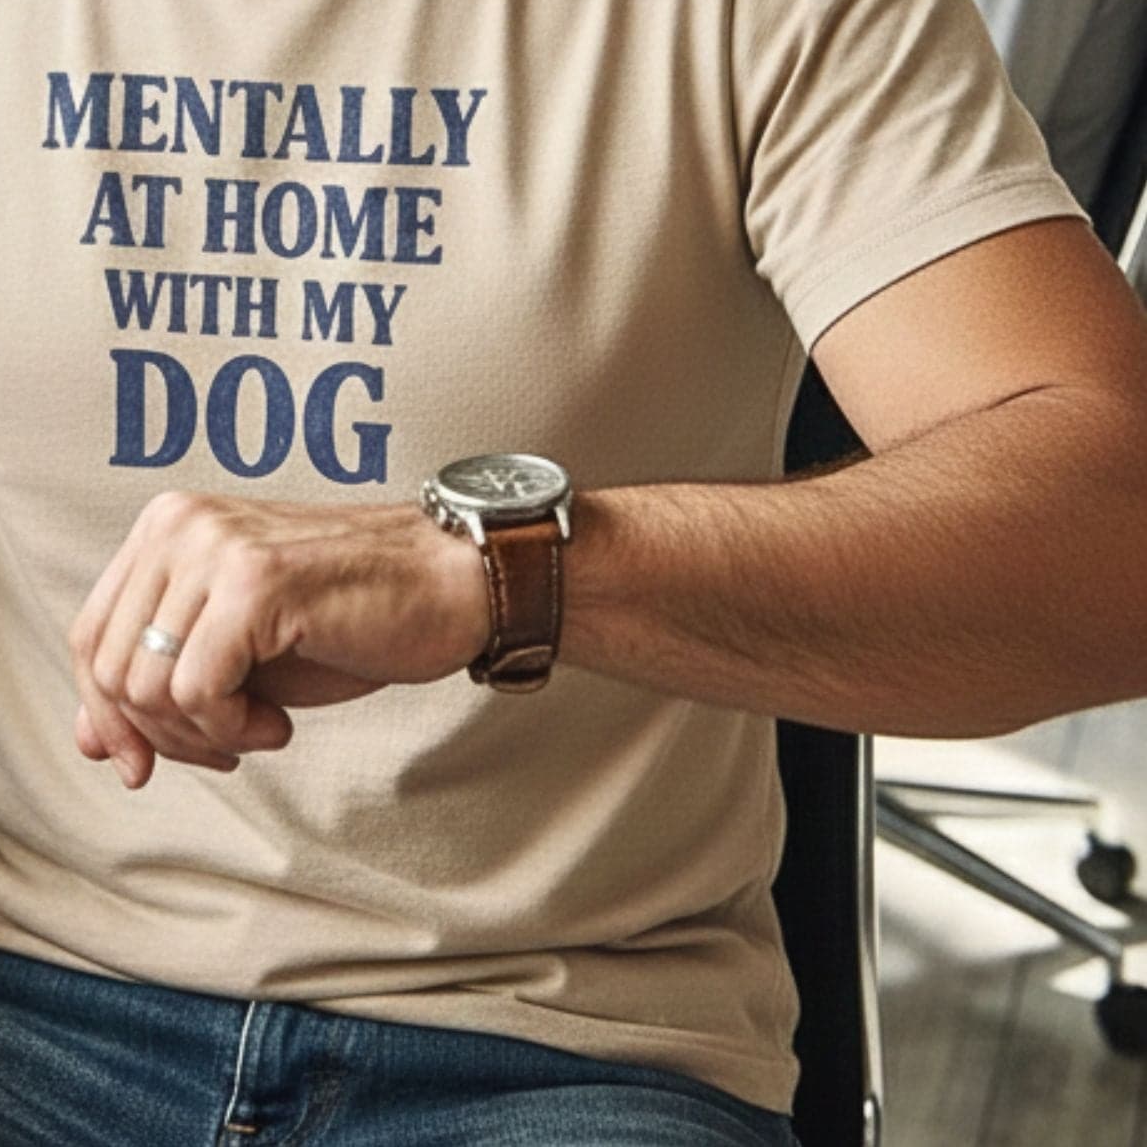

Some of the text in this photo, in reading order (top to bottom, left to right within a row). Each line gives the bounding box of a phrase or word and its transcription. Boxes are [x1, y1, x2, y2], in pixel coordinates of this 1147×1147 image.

[42, 71, 487, 167] MENTALLY
[80, 171, 443, 265] AT HOME
[104, 268, 407, 345] WITH MY
[109, 348, 393, 485] DOG
